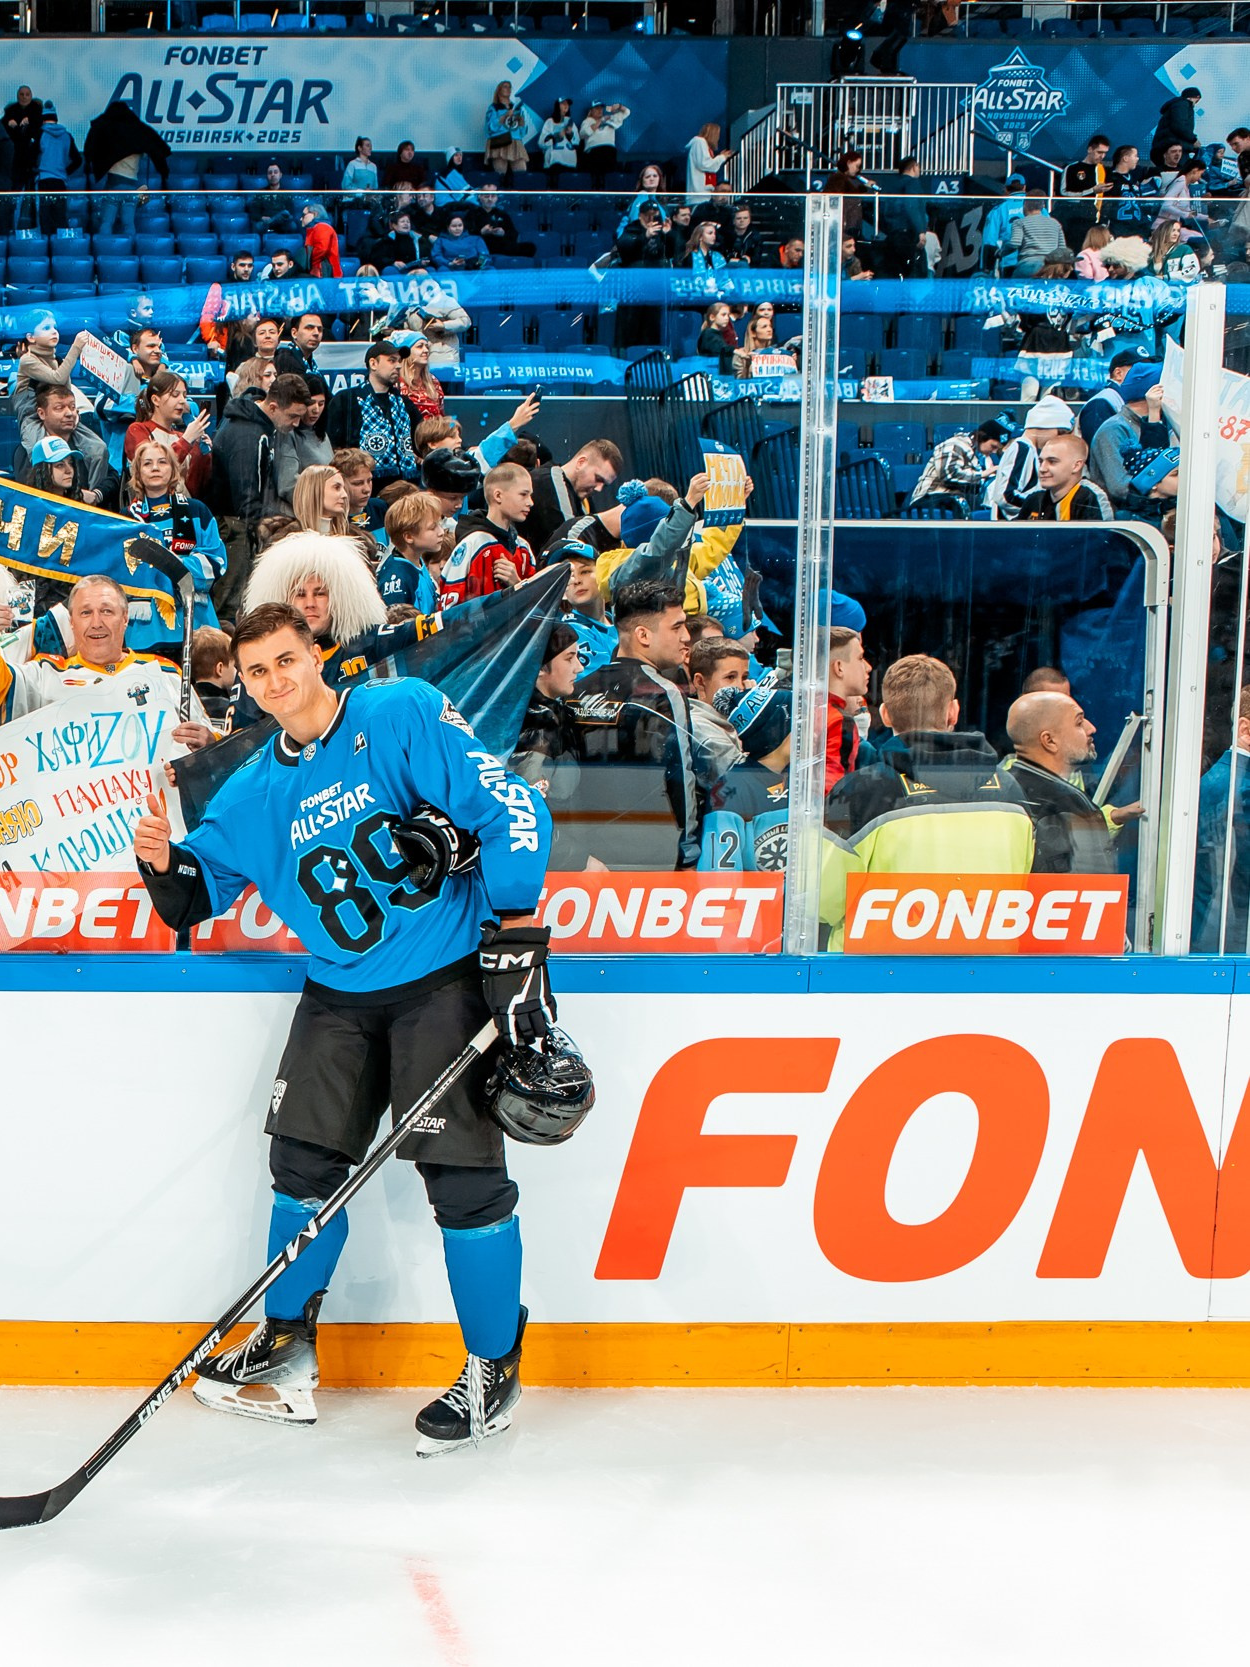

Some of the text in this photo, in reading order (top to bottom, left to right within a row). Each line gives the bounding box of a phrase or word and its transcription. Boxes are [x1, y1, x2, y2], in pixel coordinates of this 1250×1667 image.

[164, 46, 269, 65] FONBET
[997, 79, 1035, 88] FONBET
[256, 129, 302, 144] 2025
[1002, 121, 1026, 129] 2025
[935, 180, 960, 194] A3
[939, 205, 985, 278] A3
[300, 781, 342, 812] FONBET
[296, 809, 447, 956] 89
[536, 887, 776, 939] ONBET
[849, 888, 1122, 941] FONBET
[594, 1033, 1250, 1283] FON
[138, 1328, 222, 1427] ONE TIMER
